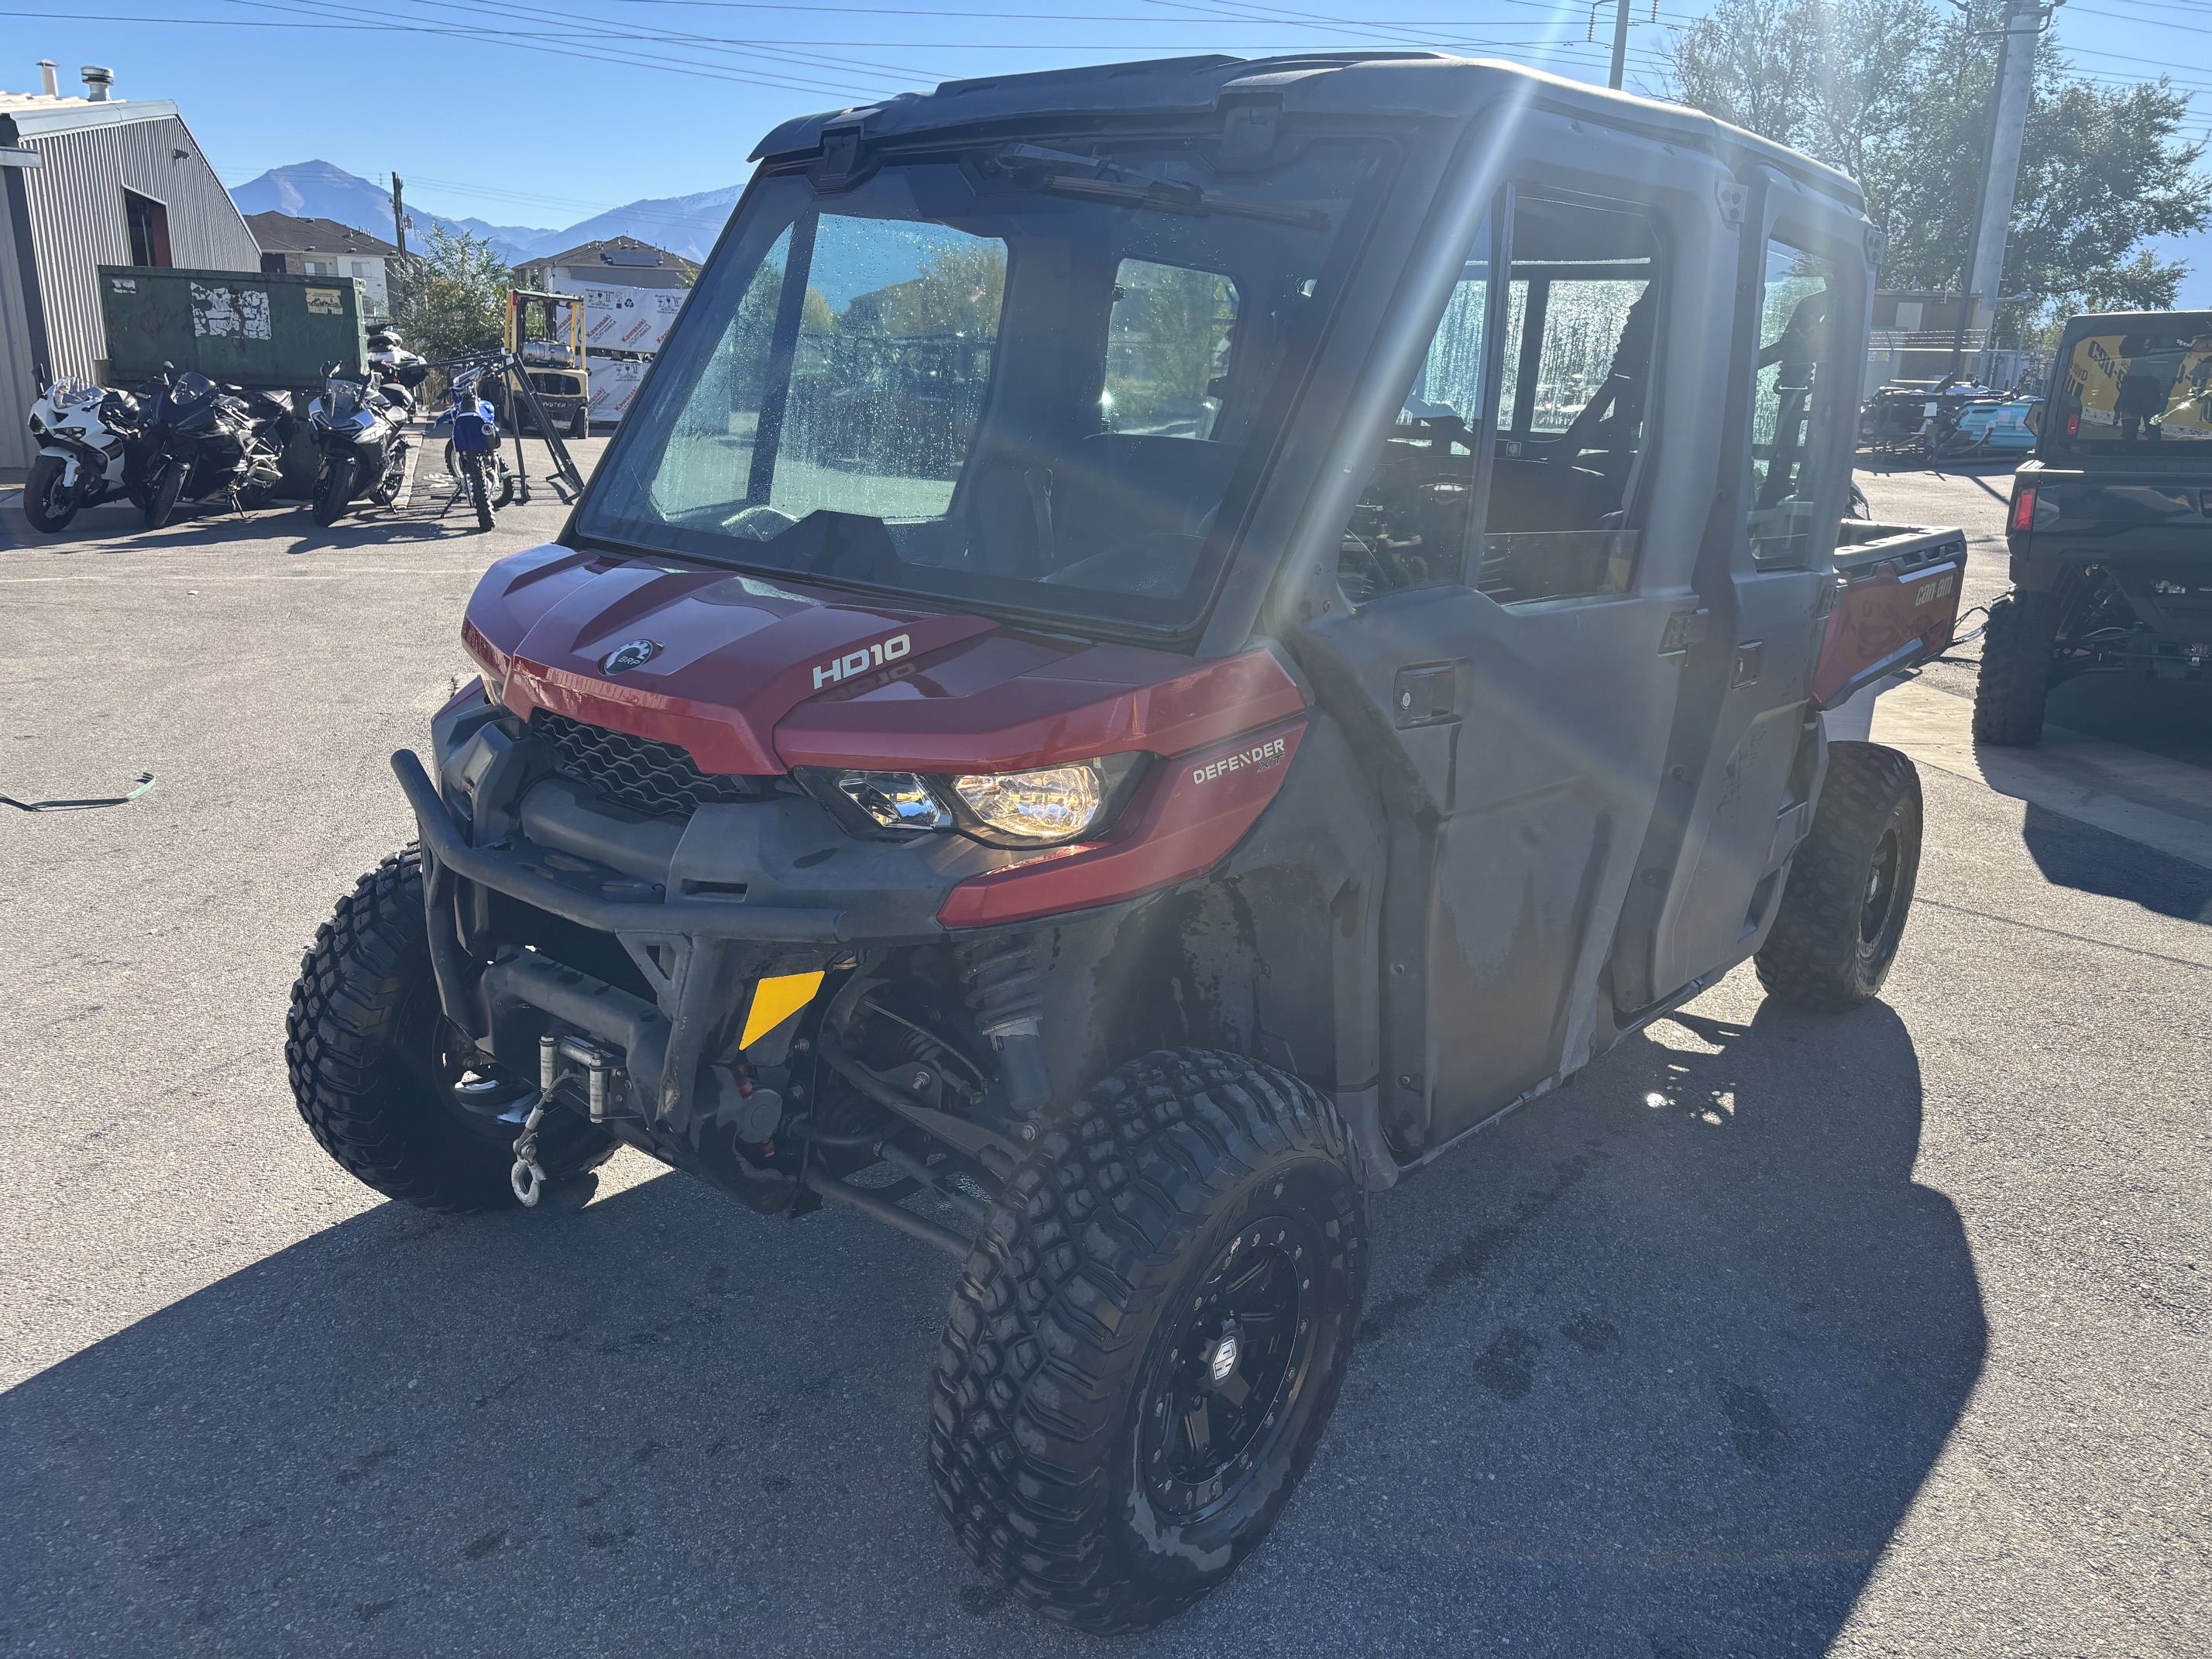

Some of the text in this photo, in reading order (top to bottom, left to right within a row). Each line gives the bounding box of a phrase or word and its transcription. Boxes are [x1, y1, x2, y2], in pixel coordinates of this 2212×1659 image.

[586, 313, 612, 338] Kawasaki
[621, 318, 647, 343] Kawasaki
[617, 656, 641, 665] BRP
[812, 634, 911, 690] HD10
[1193, 738, 1286, 785] DEFENDER
[1256, 751, 1286, 773] XT
